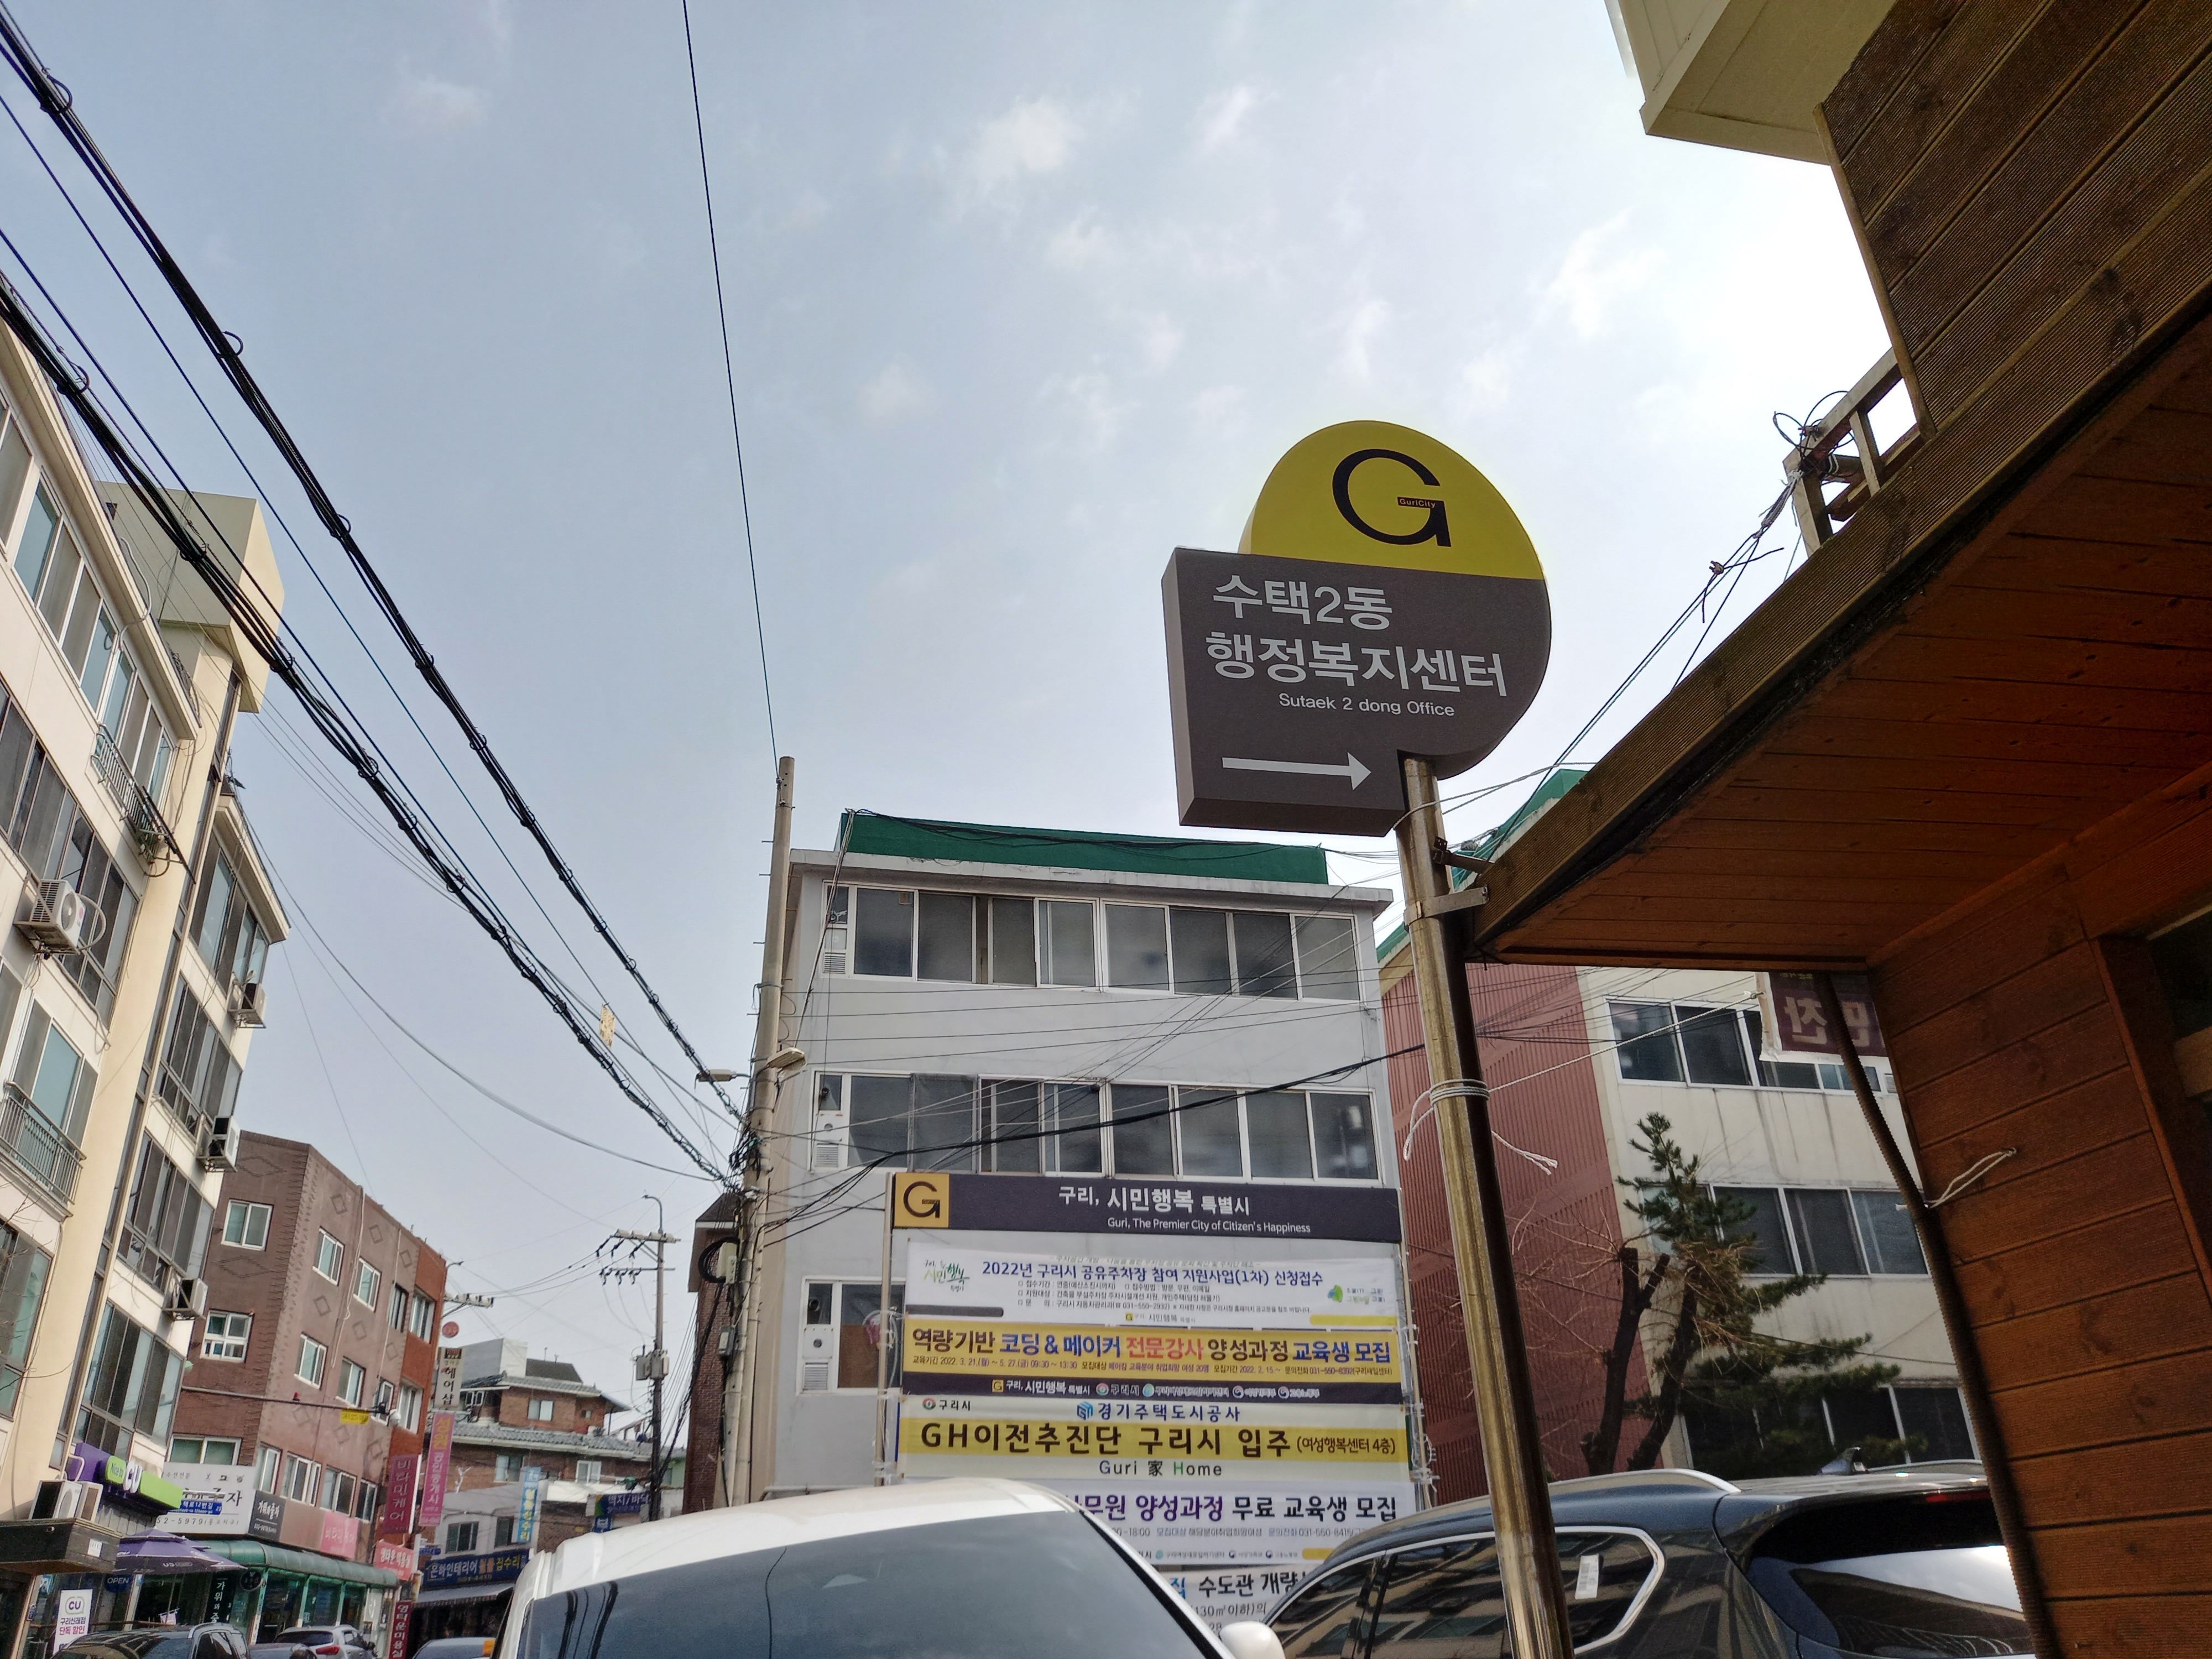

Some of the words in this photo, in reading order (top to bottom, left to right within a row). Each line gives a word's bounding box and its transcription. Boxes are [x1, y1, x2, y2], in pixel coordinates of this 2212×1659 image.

[1332, 448, 1452, 547] G
[1399, 498, 1436, 508] GuriCity
[1213, 575, 1392, 630] 수택2동
[1206, 632, 1507, 697] 행정복지센터
[1279, 692, 1337, 710] Sutaek
[1342, 697, 1353, 711] 2
[1359, 698, 1401, 716] dong
[1407, 701, 1455, 717] Office
[903, 1181, 941, 1219] G
[1058, 1186, 1099, 1206] 구리,
[1107, 1187, 1194, 1214] 시민행복
[1201, 1195, 1250, 1217] 특별시
[1107, 1217, 1131, 1230] Guri,
[1132, 1218, 1151, 1229] The
[1153, 1219, 1190, 1231] Premier
[1191, 1220, 1210, 1233] City
[1211, 1220, 1221, 1232] of
[1222, 1220, 1262, 1233] Citizen's
[1263, 1222, 1311, 1236] Happiness
[982, 1261, 1032, 1278] 2022년
[1037, 1264, 1077, 1279] 구리시
[1081, 1265, 1147, 1282] 공유주차장
[1151, 1267, 1179, 1282] 참여
[1182, 1268, 1269, 1286] 지원사업(1차)
[1274, 1270, 1323, 1286] 신청접수
[912, 1328, 995, 1354] 역량기반
[999, 1333, 1040, 1355] 코딩
[1045, 1334, 1059, 1355] &
[1063, 1334, 1120, 1358] 메이커
[1125, 1335, 1204, 1360] 전문강사
[1207, 1338, 1288, 1362] 양성과정
[1292, 1340, 1350, 1363] 교육생
[1354, 1341, 1391, 1364] 모집
[442, 1367, 456, 1405] 헤어샵
[1025, 1380, 1066, 1394] 시민행복
[938, 1400, 971, 1411] 구리시
[1097, 1402, 1241, 1422] 경기주택도시공사
[921, 1422, 1122, 1455] GH이전추진단
[1139, 1427, 1221, 1455] 구리시
[1238, 1428, 1291, 1458] 입주
[1296, 1435, 1370, 1454] (여성행복센터
[1372, 1438, 1396, 1455] 4층)
[123, 1460, 143, 1494] CU
[1099, 1460, 1138, 1475] Guri
[1147, 1461, 1163, 1477] 家
[1173, 1461, 1223, 1476] Home
[608, 1493, 651, 1506] 벽지/바닥
[1074, 1494, 1126, 1521] 무원
[1135, 1495, 1223, 1522] 양성과정
[1232, 1496, 1275, 1521] 무료
[1283, 1495, 1348, 1522] 교육생
[1355, 1496, 1396, 1523] 모집
[1198, 1574, 1254, 1598] 수도관
[1260, 1571, 1306, 1594] 개량
[68, 1601, 81, 1610] CU
